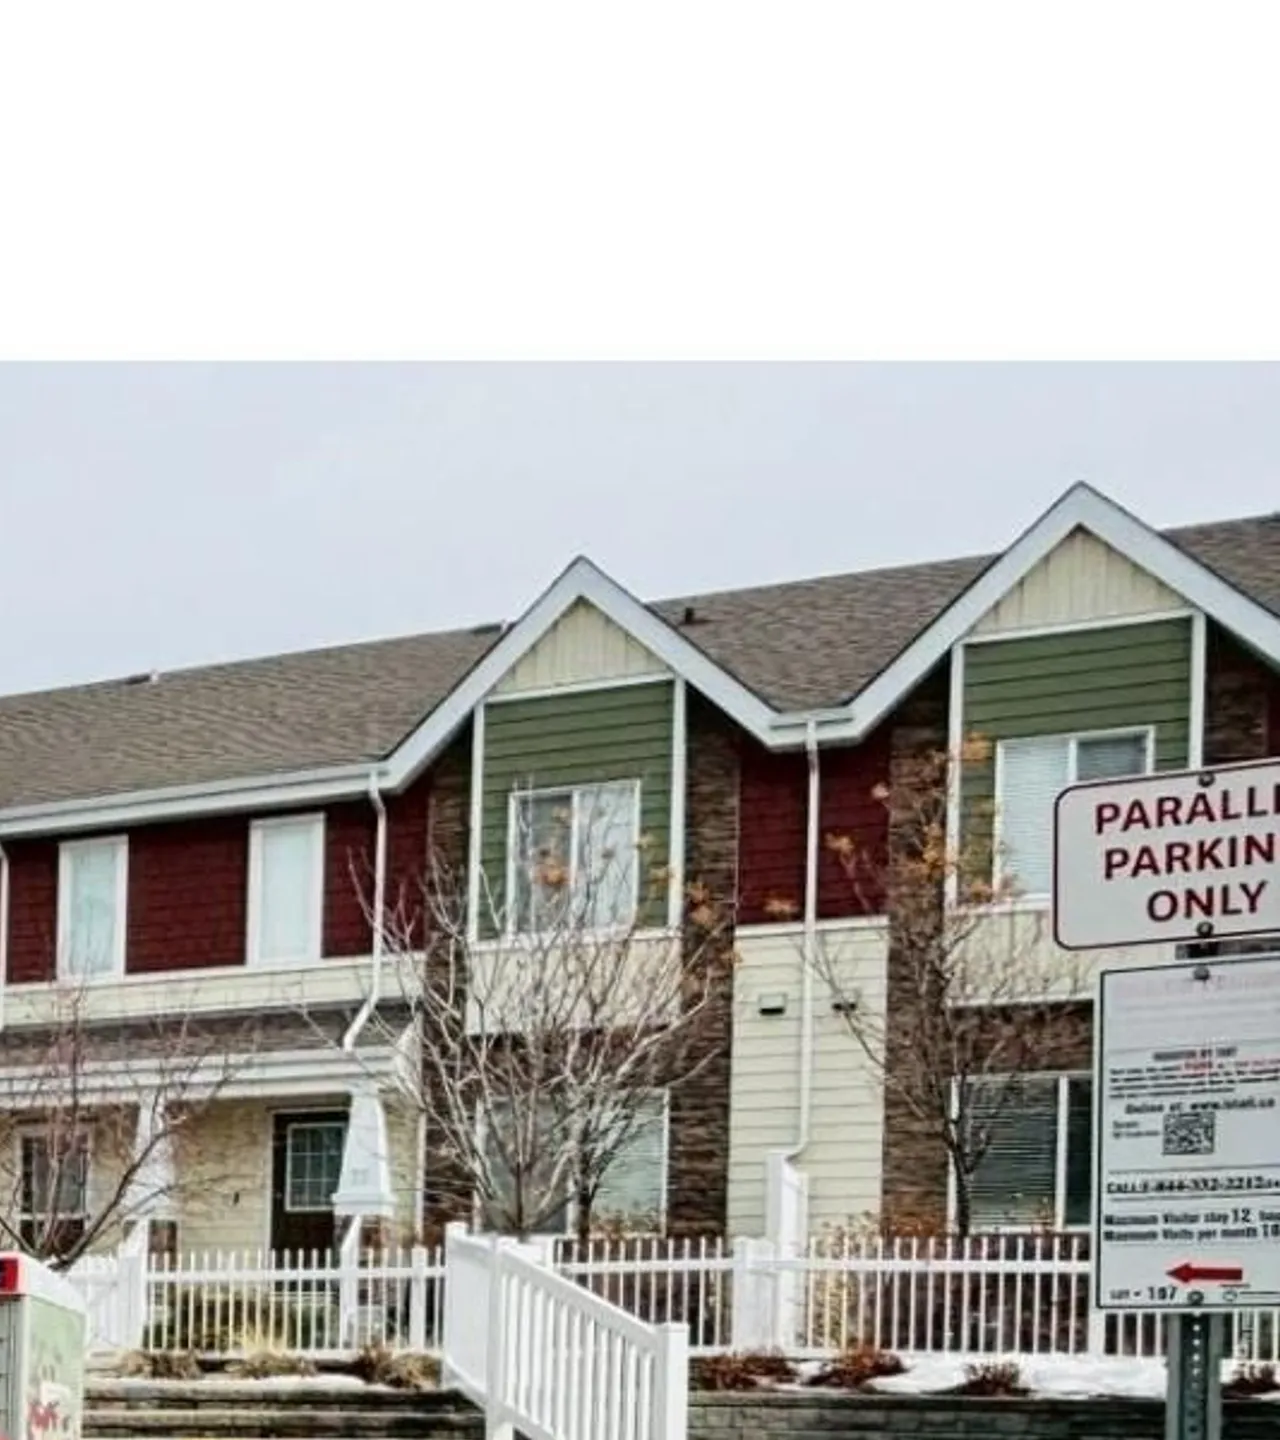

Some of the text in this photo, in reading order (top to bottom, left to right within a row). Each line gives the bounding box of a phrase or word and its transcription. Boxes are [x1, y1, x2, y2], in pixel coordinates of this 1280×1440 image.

[1095, 783, 1280, 835] PARALL
[1104, 832, 1275, 880] PARKIN
[1147, 880, 1268, 922] ONLY
[1231, 1208, 1251, 1223] 12
